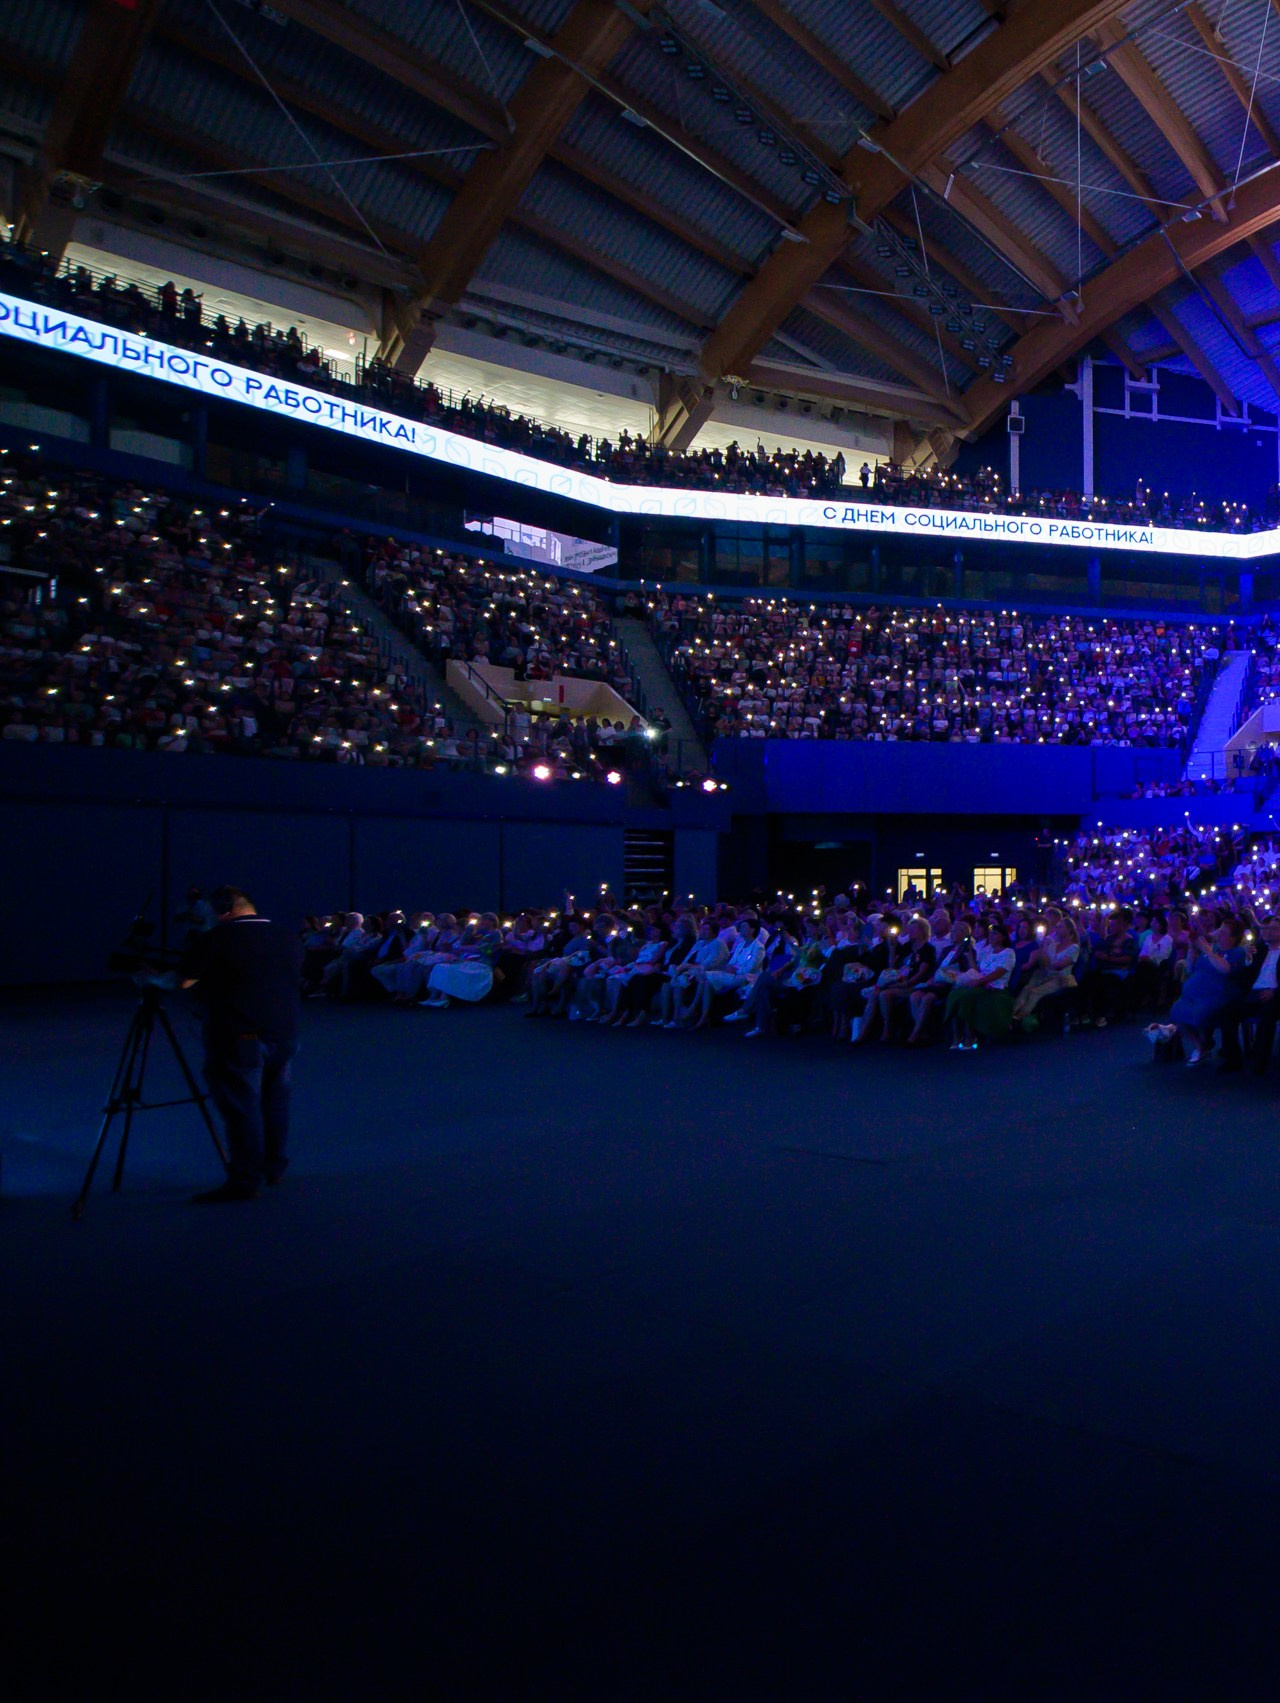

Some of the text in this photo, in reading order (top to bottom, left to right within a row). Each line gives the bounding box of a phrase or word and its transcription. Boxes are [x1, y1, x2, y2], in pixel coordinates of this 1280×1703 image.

[245, 377, 416, 443] РАБОТНИКА!
[823, 506, 837, 520] С
[904, 513, 1042, 535] СОЦИАЛЬНОГО
[1049, 524, 1153, 545] РАБОТНИКА!
